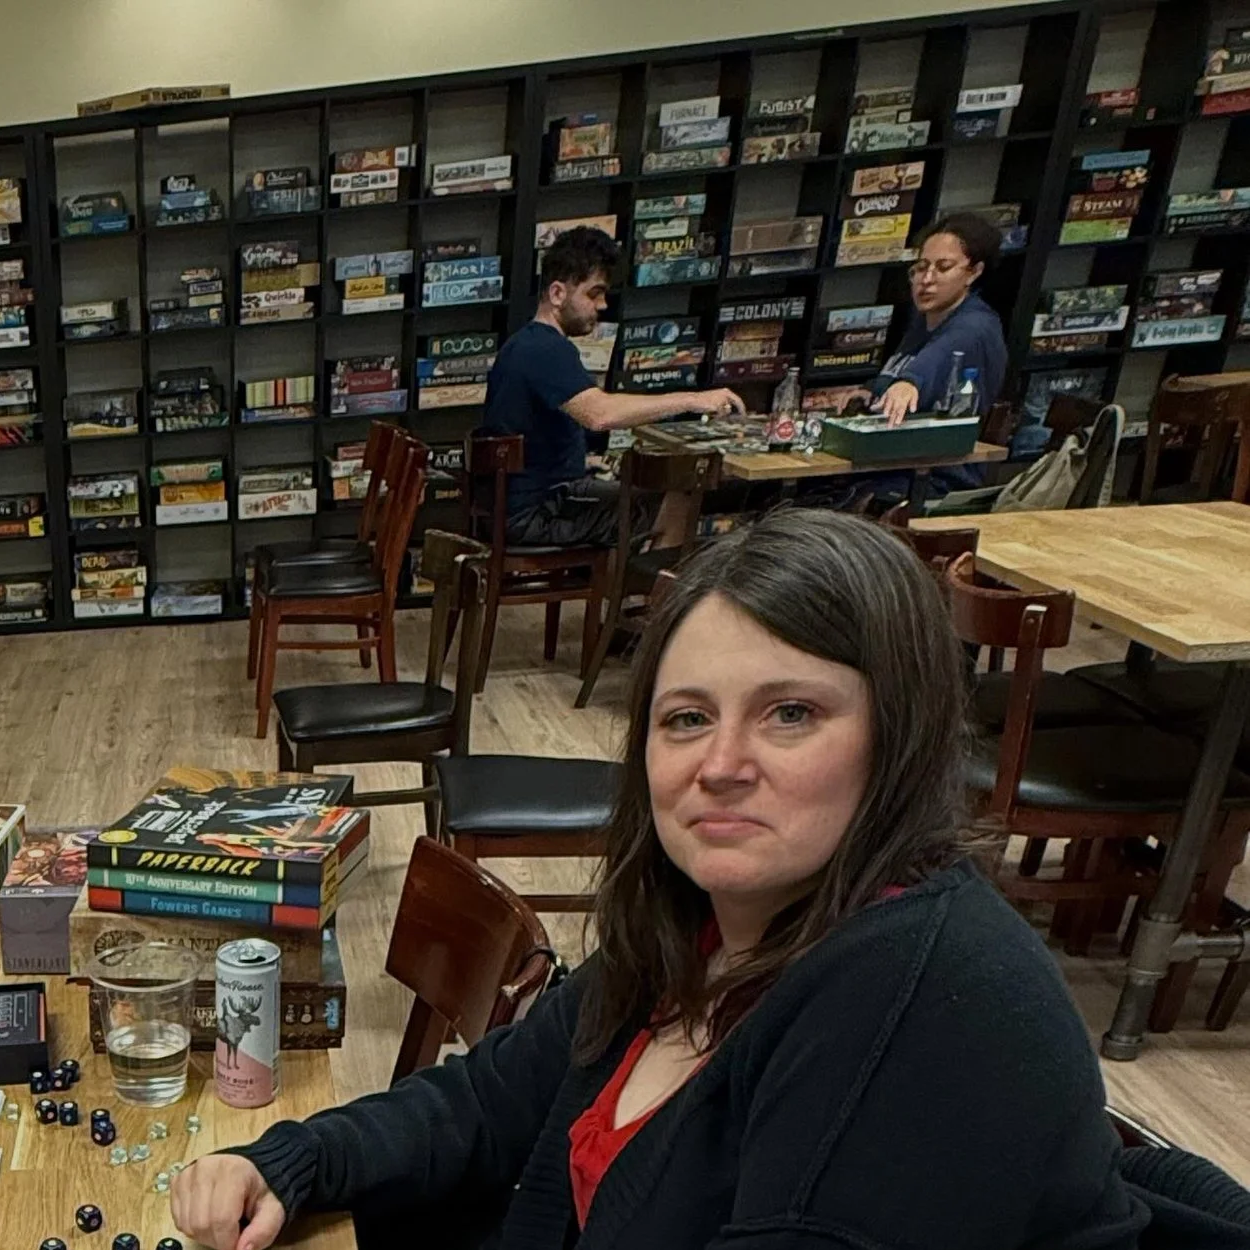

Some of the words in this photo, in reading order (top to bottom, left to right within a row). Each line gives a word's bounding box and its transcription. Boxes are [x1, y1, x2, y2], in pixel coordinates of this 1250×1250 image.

[1083, 200, 1123, 212] STEAM
[735, 301, 790, 320] COLONY
[136, 852, 262, 876] PAPERBACK
[214, 881, 258, 898] EDITION
